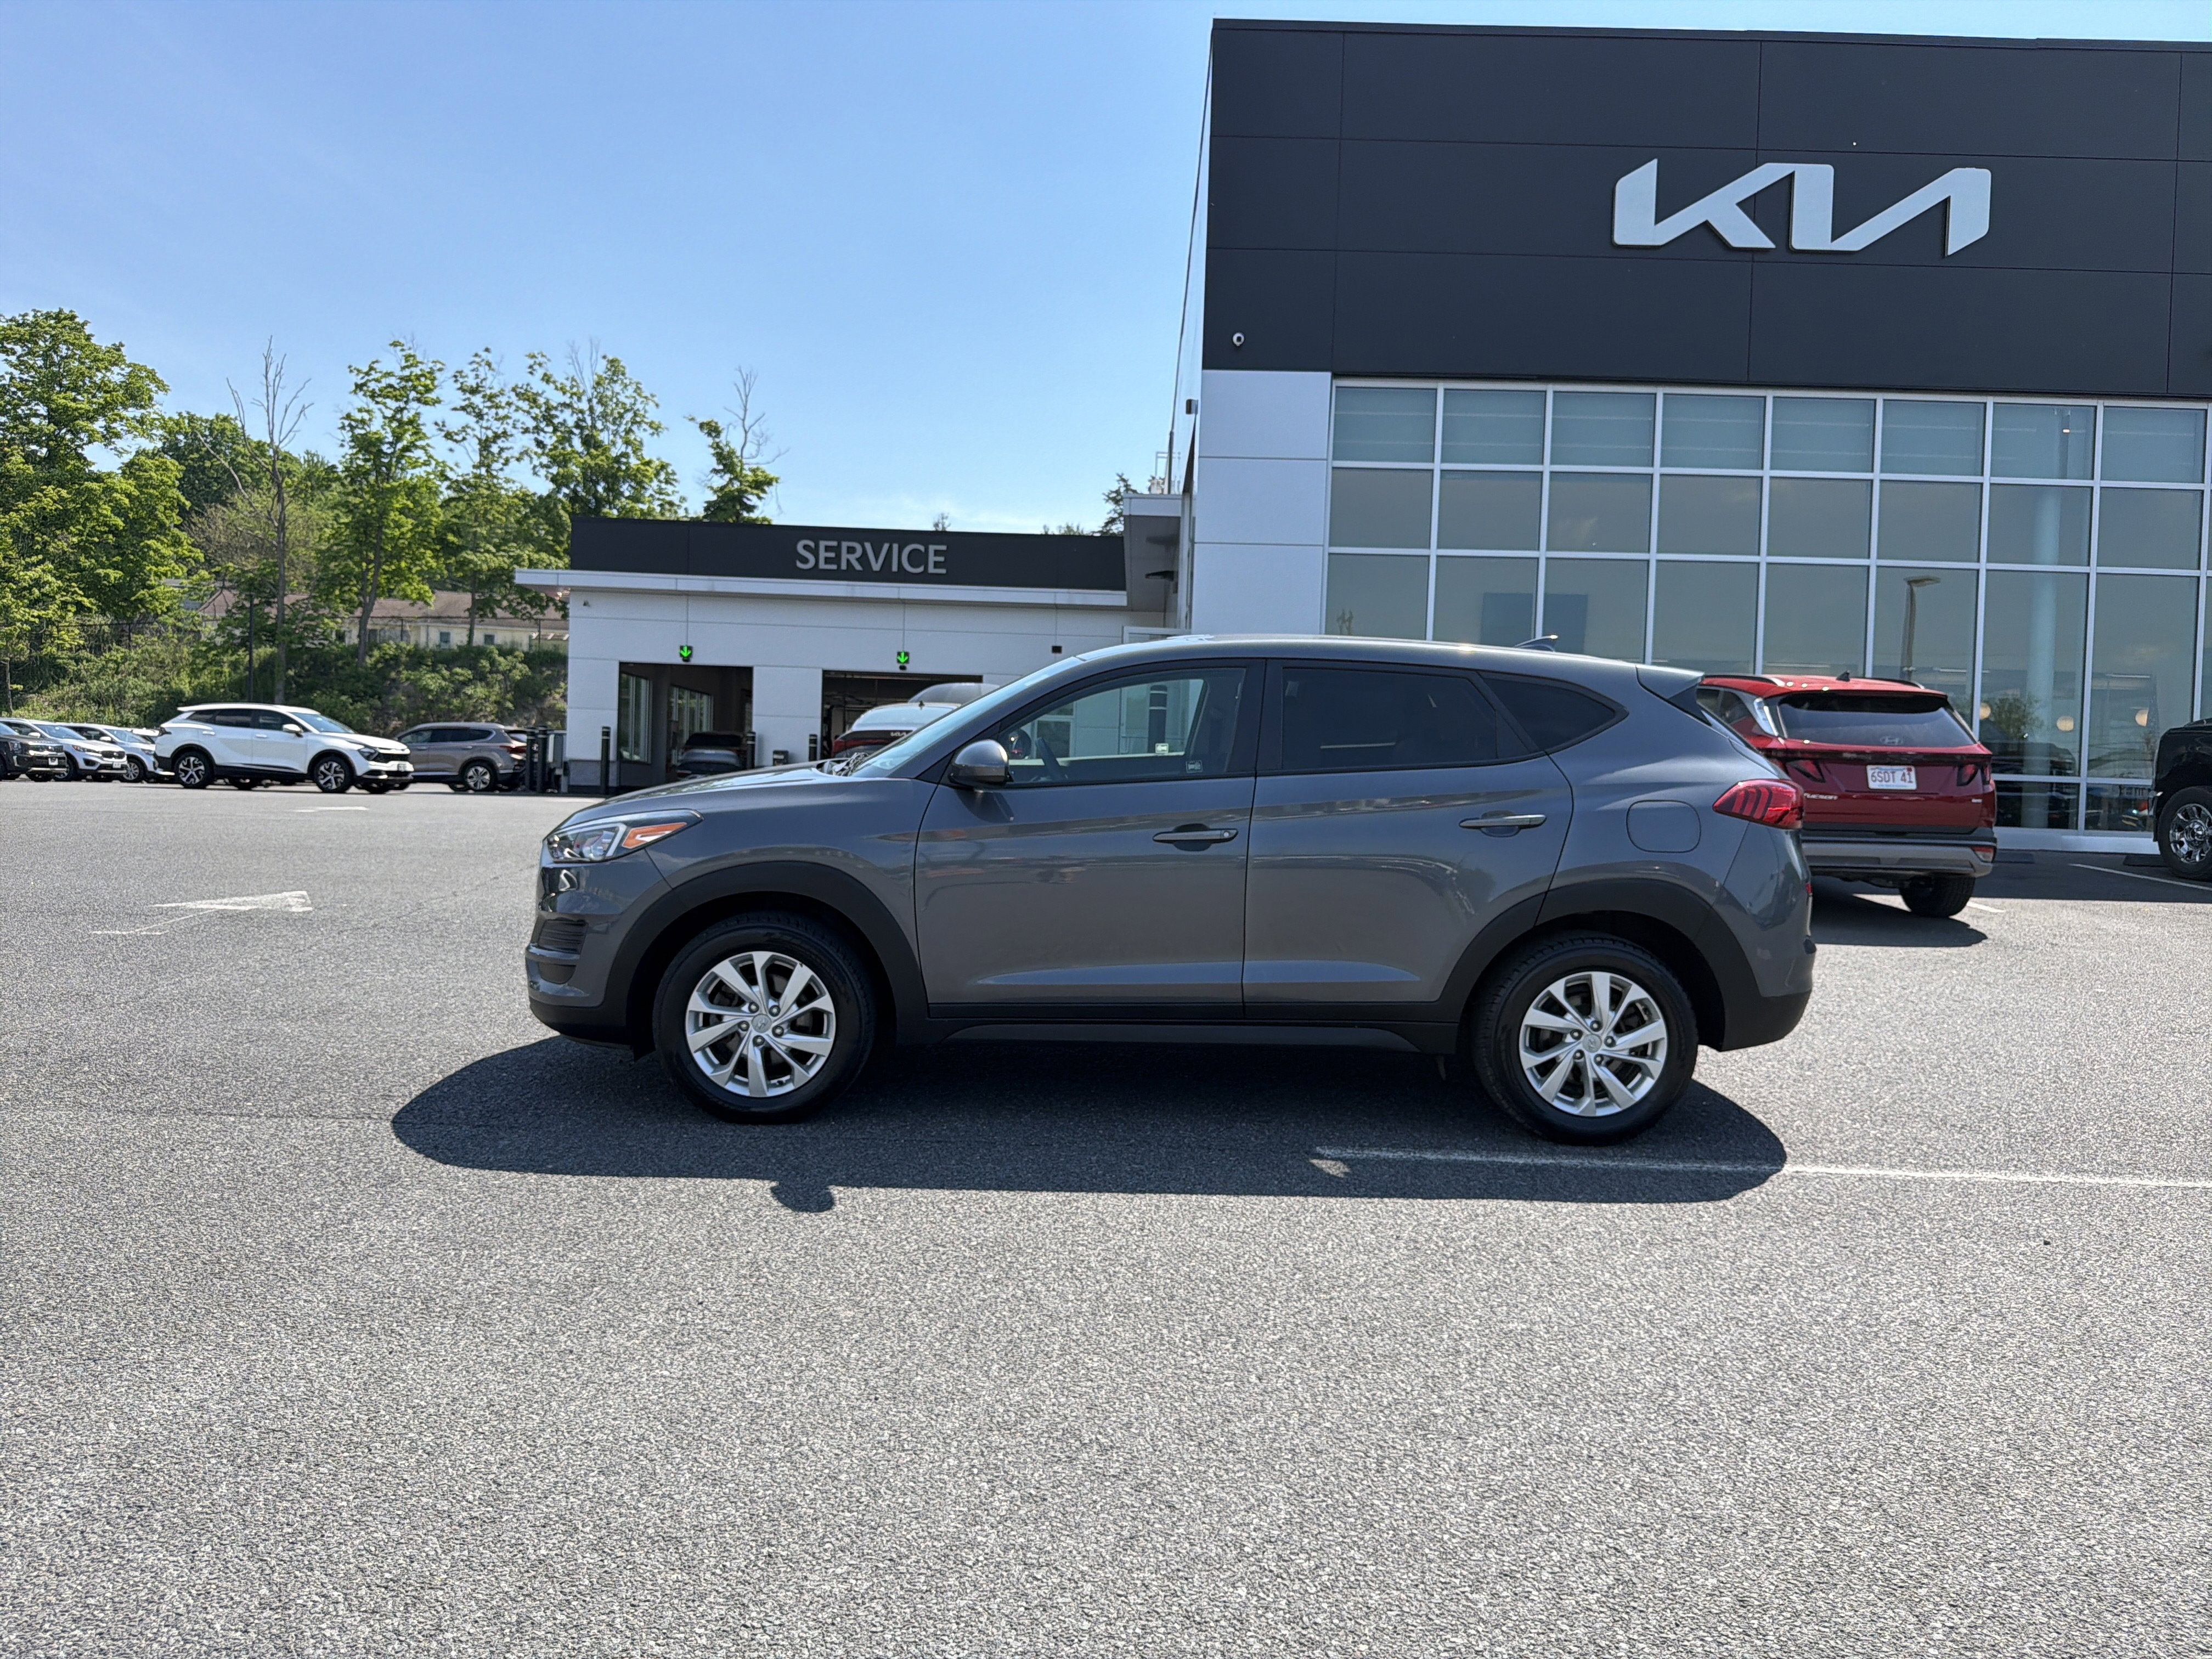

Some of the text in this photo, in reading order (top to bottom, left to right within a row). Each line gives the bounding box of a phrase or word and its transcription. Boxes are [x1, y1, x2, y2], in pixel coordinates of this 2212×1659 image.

[1613, 158, 1992, 256] KIA
[796, 539, 947, 574] SERVICE
[1900, 771, 1913, 783] 41
